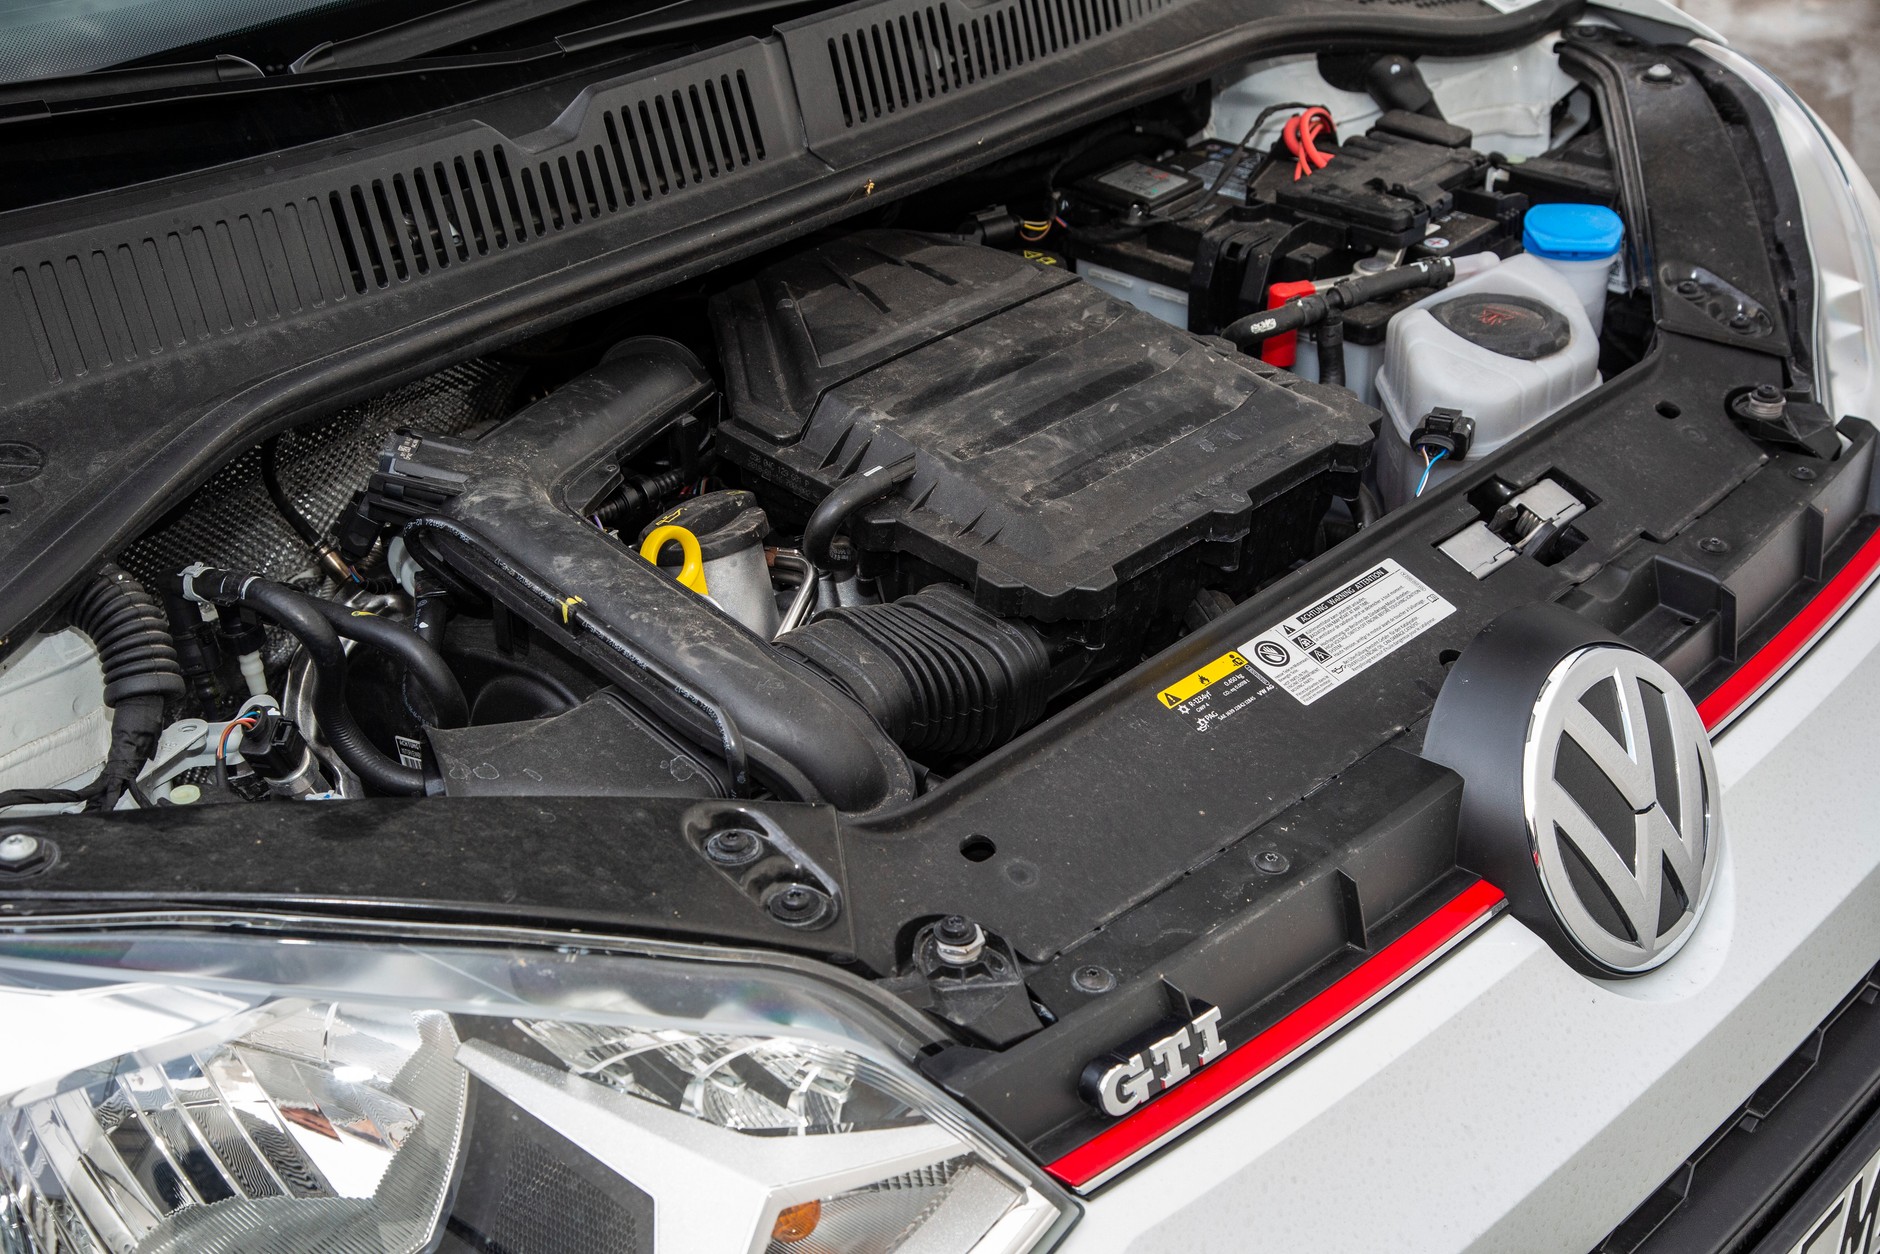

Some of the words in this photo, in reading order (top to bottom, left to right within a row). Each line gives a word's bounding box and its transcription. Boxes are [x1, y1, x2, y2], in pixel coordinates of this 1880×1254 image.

[1300, 604, 1328, 622] ACHTUNG
[1354, 570, 1385, 589] ATTENTION
[1188, 691, 1213, 708] R-1234yf
[1204, 711, 1218, 721] PAG
[1098, 1005, 1228, 1116] GTI
